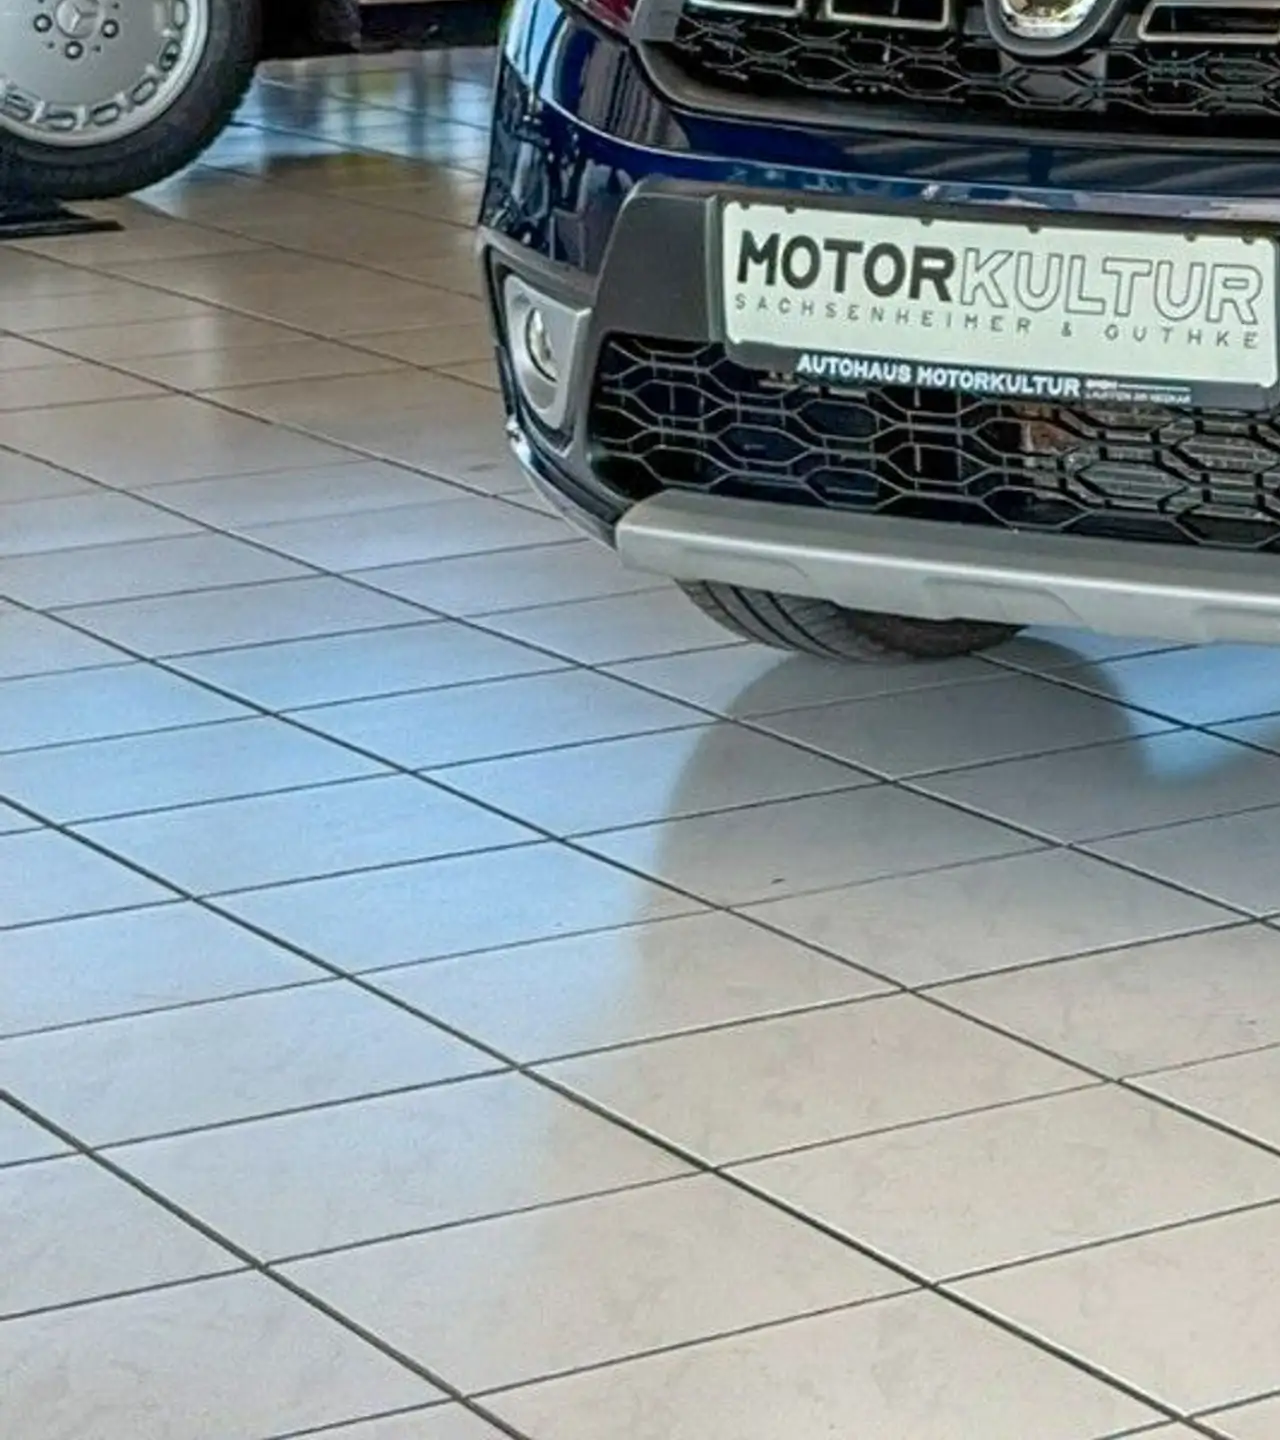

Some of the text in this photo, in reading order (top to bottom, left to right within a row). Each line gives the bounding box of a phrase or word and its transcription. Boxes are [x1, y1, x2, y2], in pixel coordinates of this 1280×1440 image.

[736, 230, 1264, 325] MOTORKULTUR
[735, 292, 1032, 334] SACHSENHEIMER
[1060, 320, 1075, 339] &
[798, 354, 911, 384] AUTOHAUS
[915, 366, 1082, 399] MOTORKULTUR
